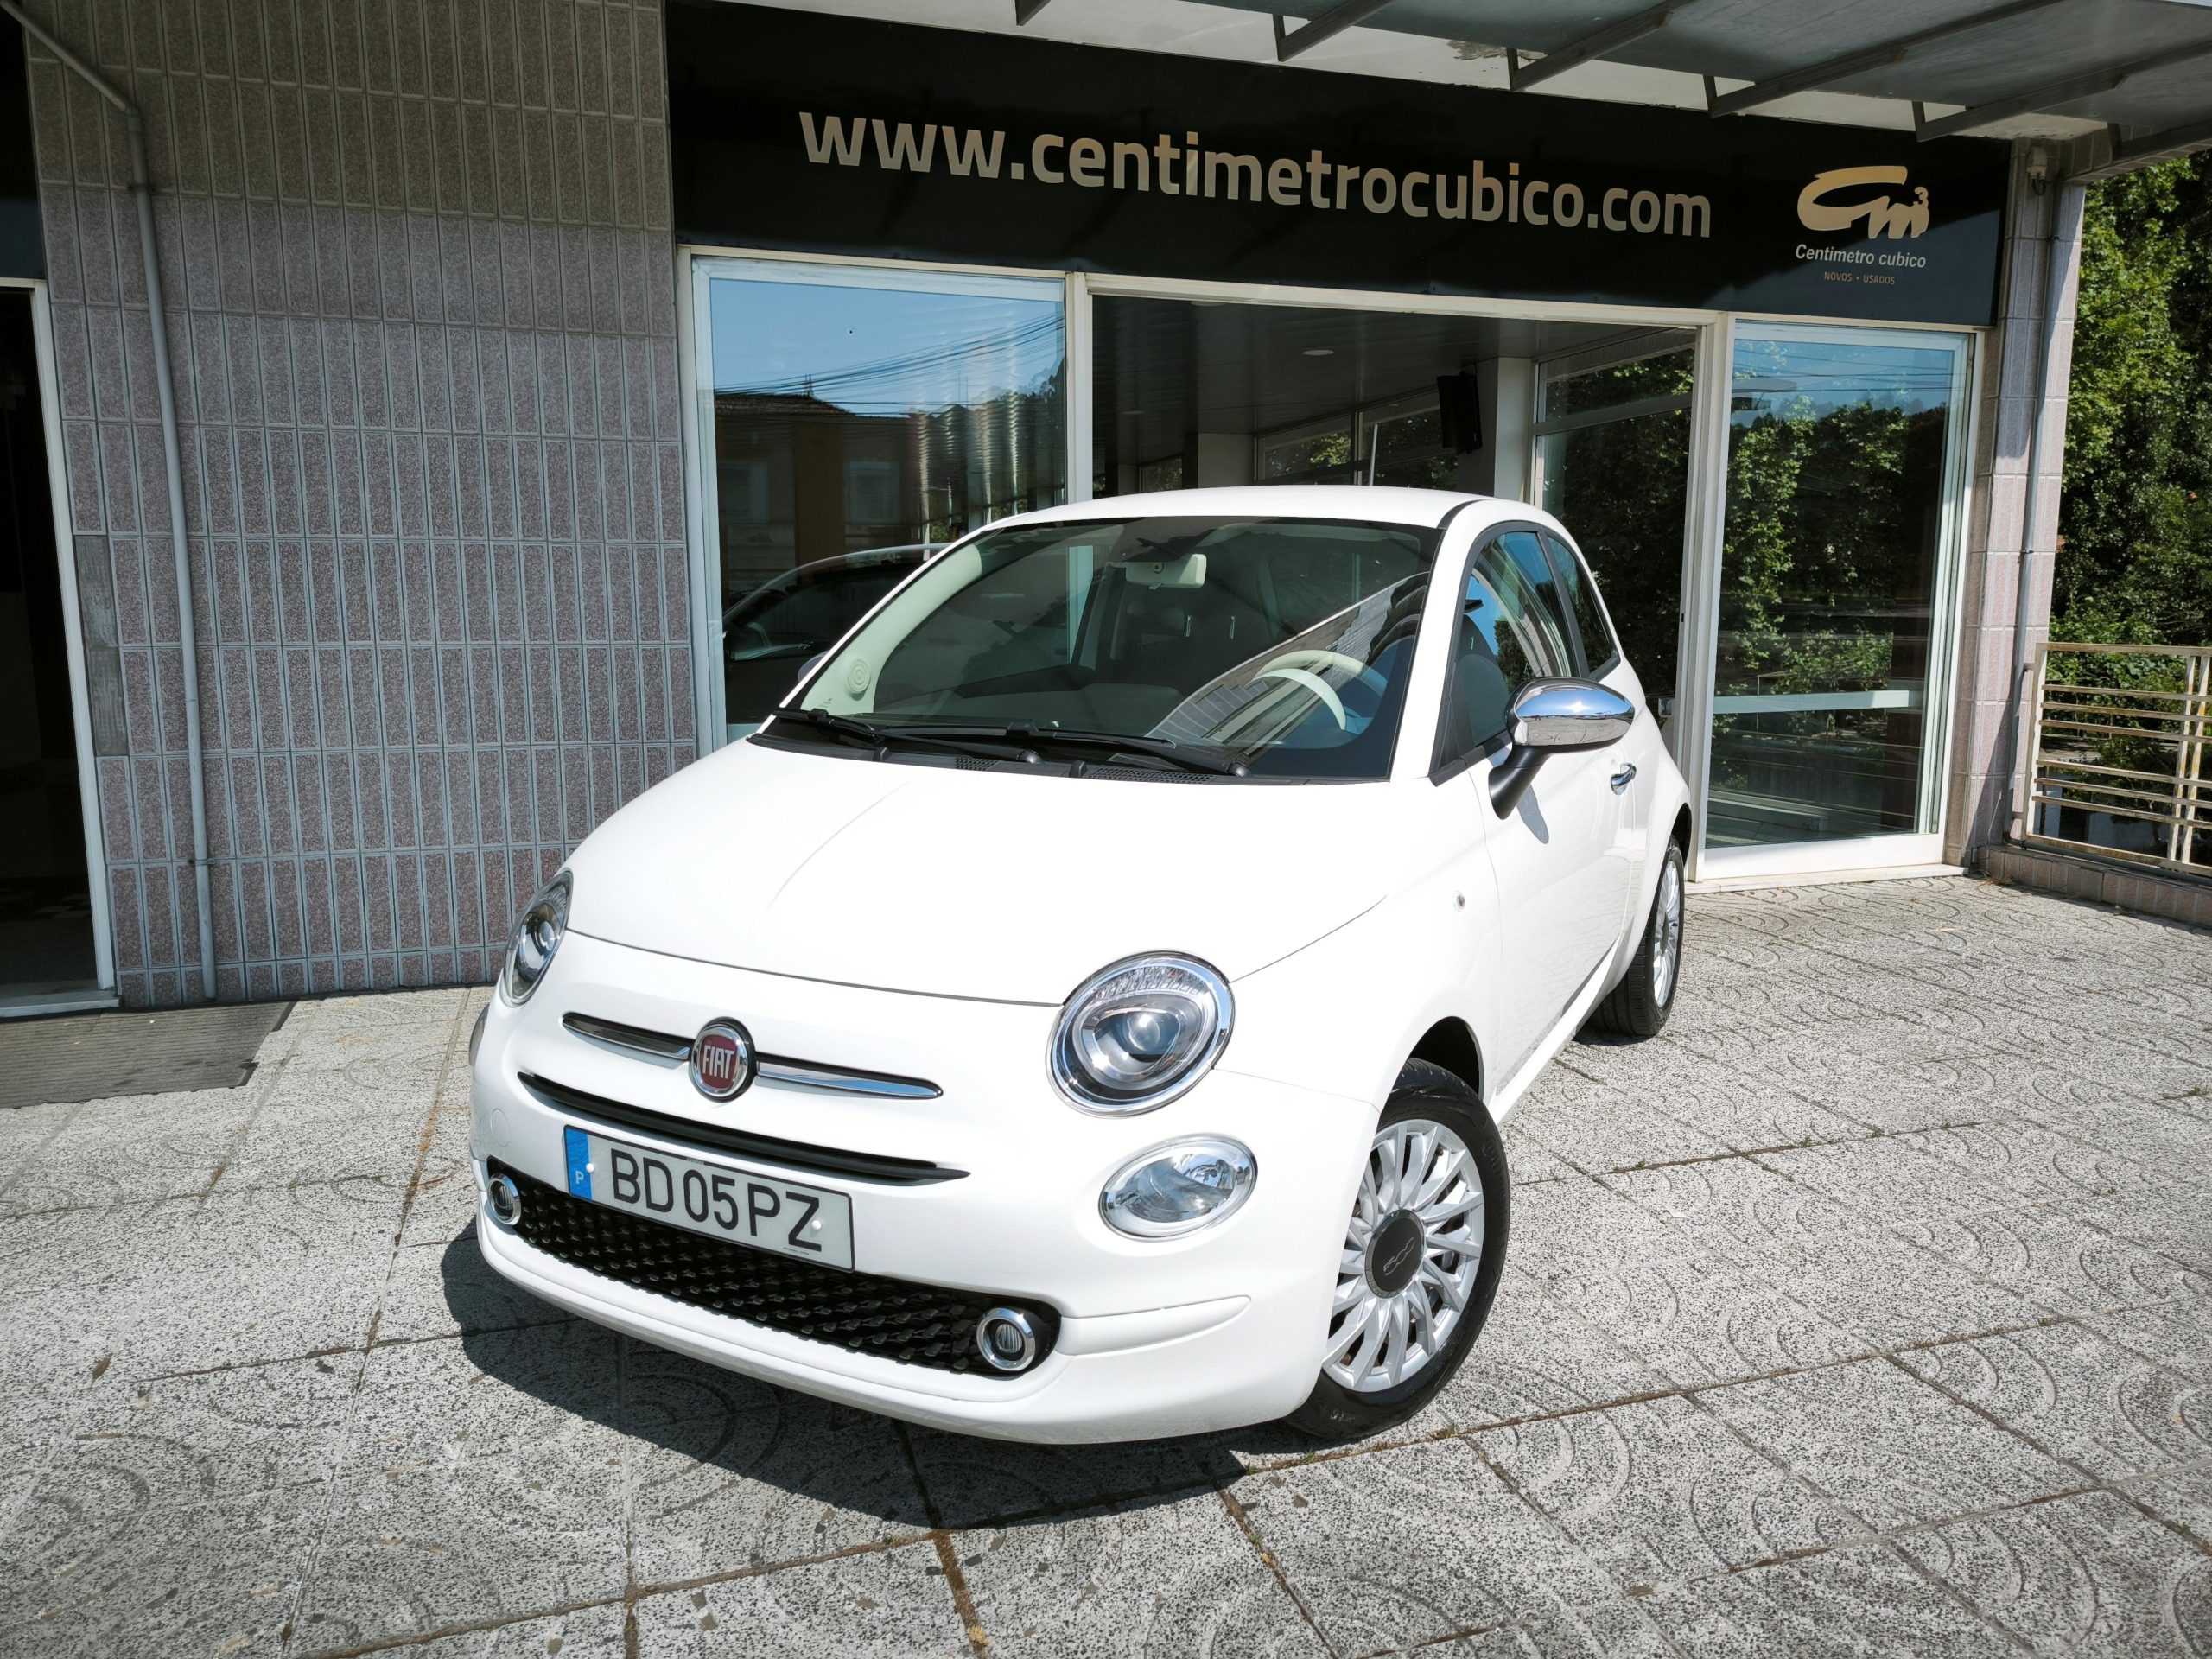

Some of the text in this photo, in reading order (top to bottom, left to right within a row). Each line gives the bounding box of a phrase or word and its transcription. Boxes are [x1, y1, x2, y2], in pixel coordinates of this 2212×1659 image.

[798, 111, 1712, 238] www.centimetrocubico.com
[1795, 244, 1926, 268] Centimetro cubico
[1824, 271, 1896, 285] NOVOS USADOS
[702, 1044, 735, 1080] FIAT
[575, 1170, 585, 1185] P
